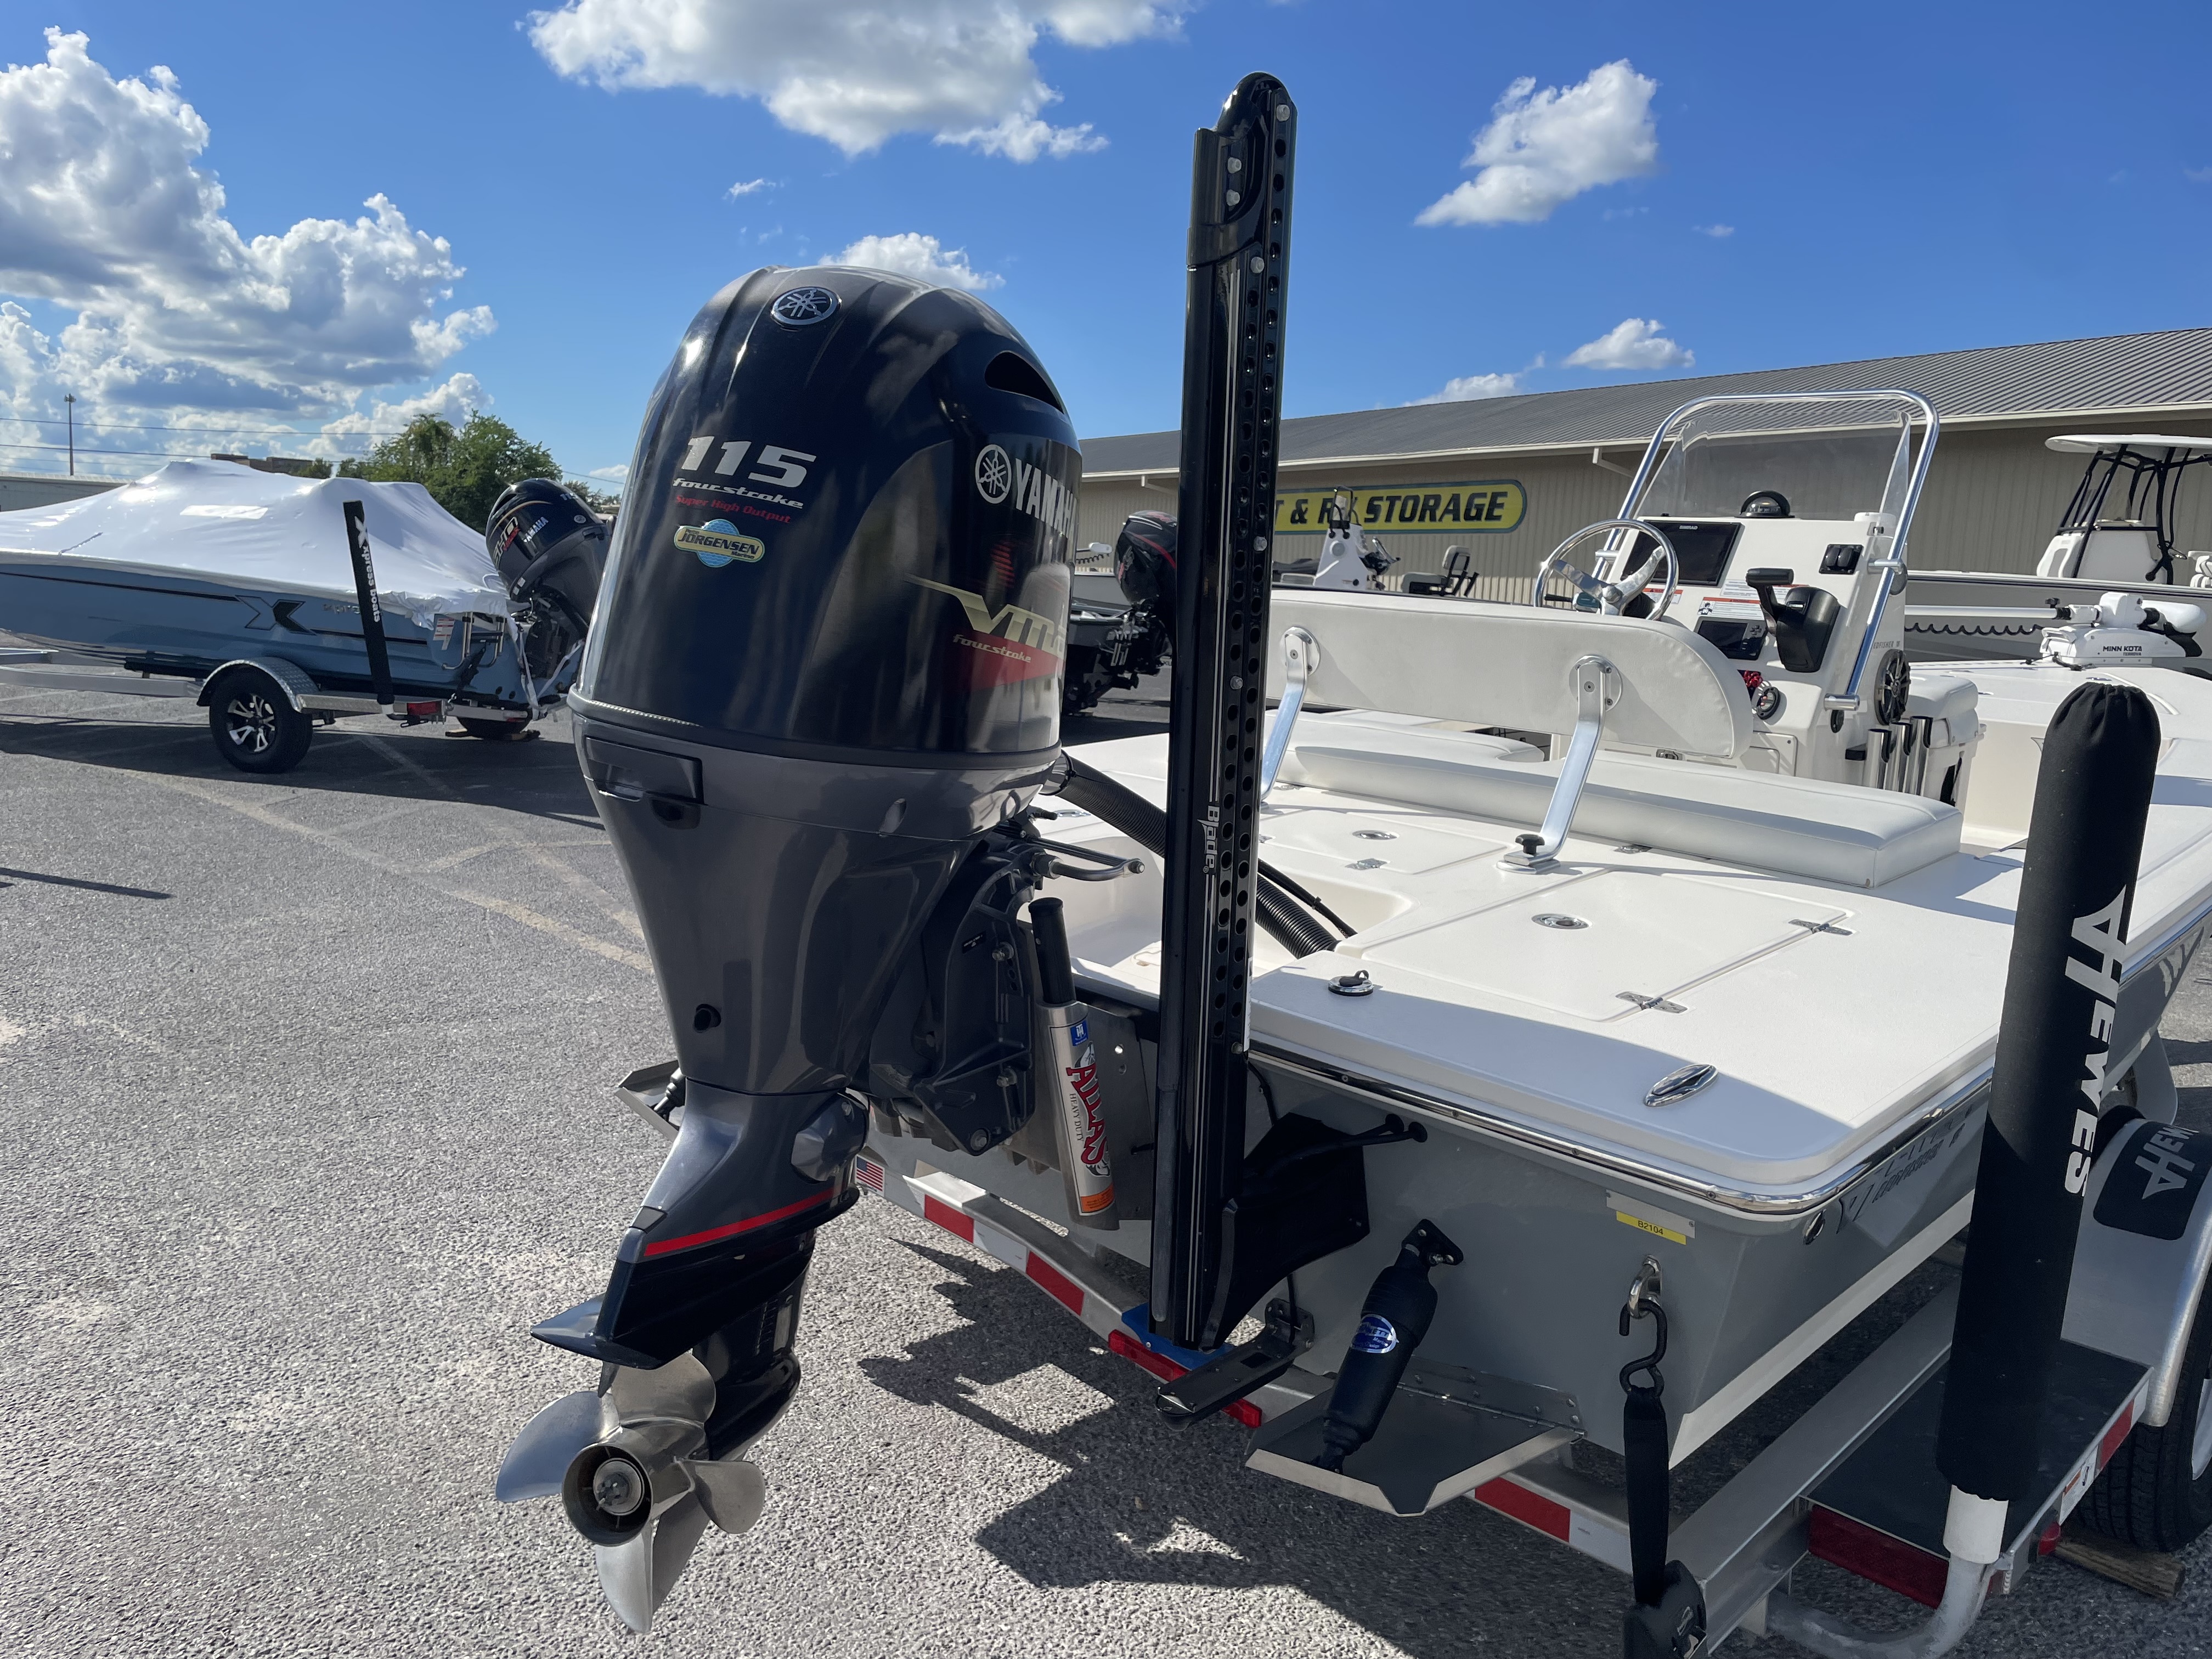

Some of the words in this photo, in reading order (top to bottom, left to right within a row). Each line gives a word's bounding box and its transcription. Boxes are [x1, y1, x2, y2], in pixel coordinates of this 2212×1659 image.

[681, 436, 816, 488] 115
[676, 495, 709, 506] Super
[711, 499, 741, 512] High
[743, 505, 791, 524] Output
[1364, 492, 1508, 523] STORAGE
[678, 533, 760, 555] JORGENSEN
[362, 545, 375, 586] xpress
[370, 588, 381, 623] boats
[2064, 884, 2126, 1197] HEWES
[1065, 1063, 1107, 1165] ATLAS
[1069, 1093, 1080, 1122] HEAVY
[1075, 1120, 1084, 1142] DUTY
[1638, 1220, 1663, 1235] B2104
